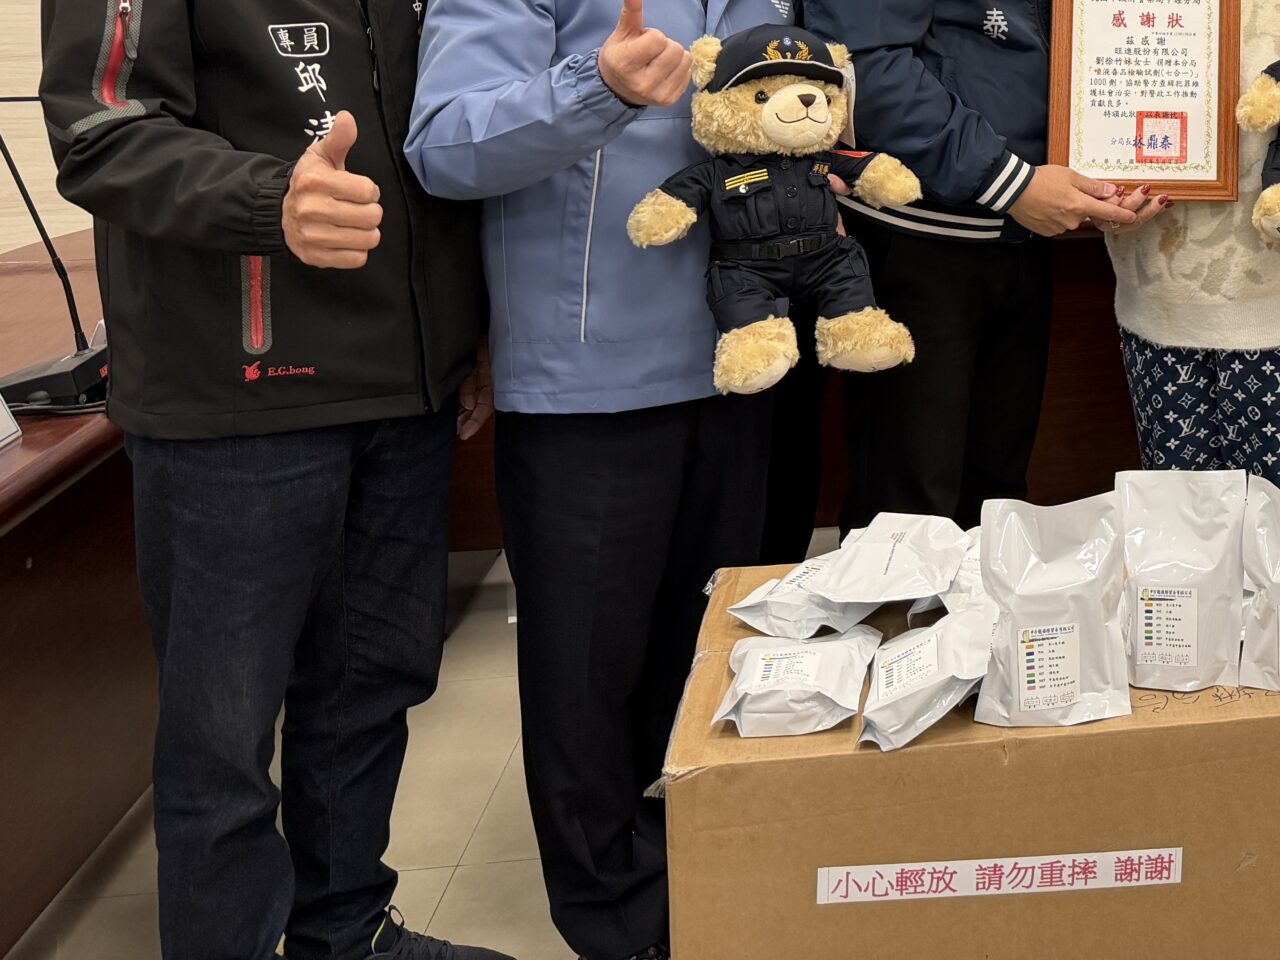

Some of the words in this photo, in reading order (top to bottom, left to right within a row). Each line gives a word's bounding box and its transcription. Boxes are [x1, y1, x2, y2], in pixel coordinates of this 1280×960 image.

[1111, 10, 1185, 29] 感謝狀
[276, 26, 320, 53] 專員
[831, 866, 958, 899] 小心輕放
[975, 858, 1098, 891] 請勿重摔
[1114, 853, 1174, 883] 謝謝
